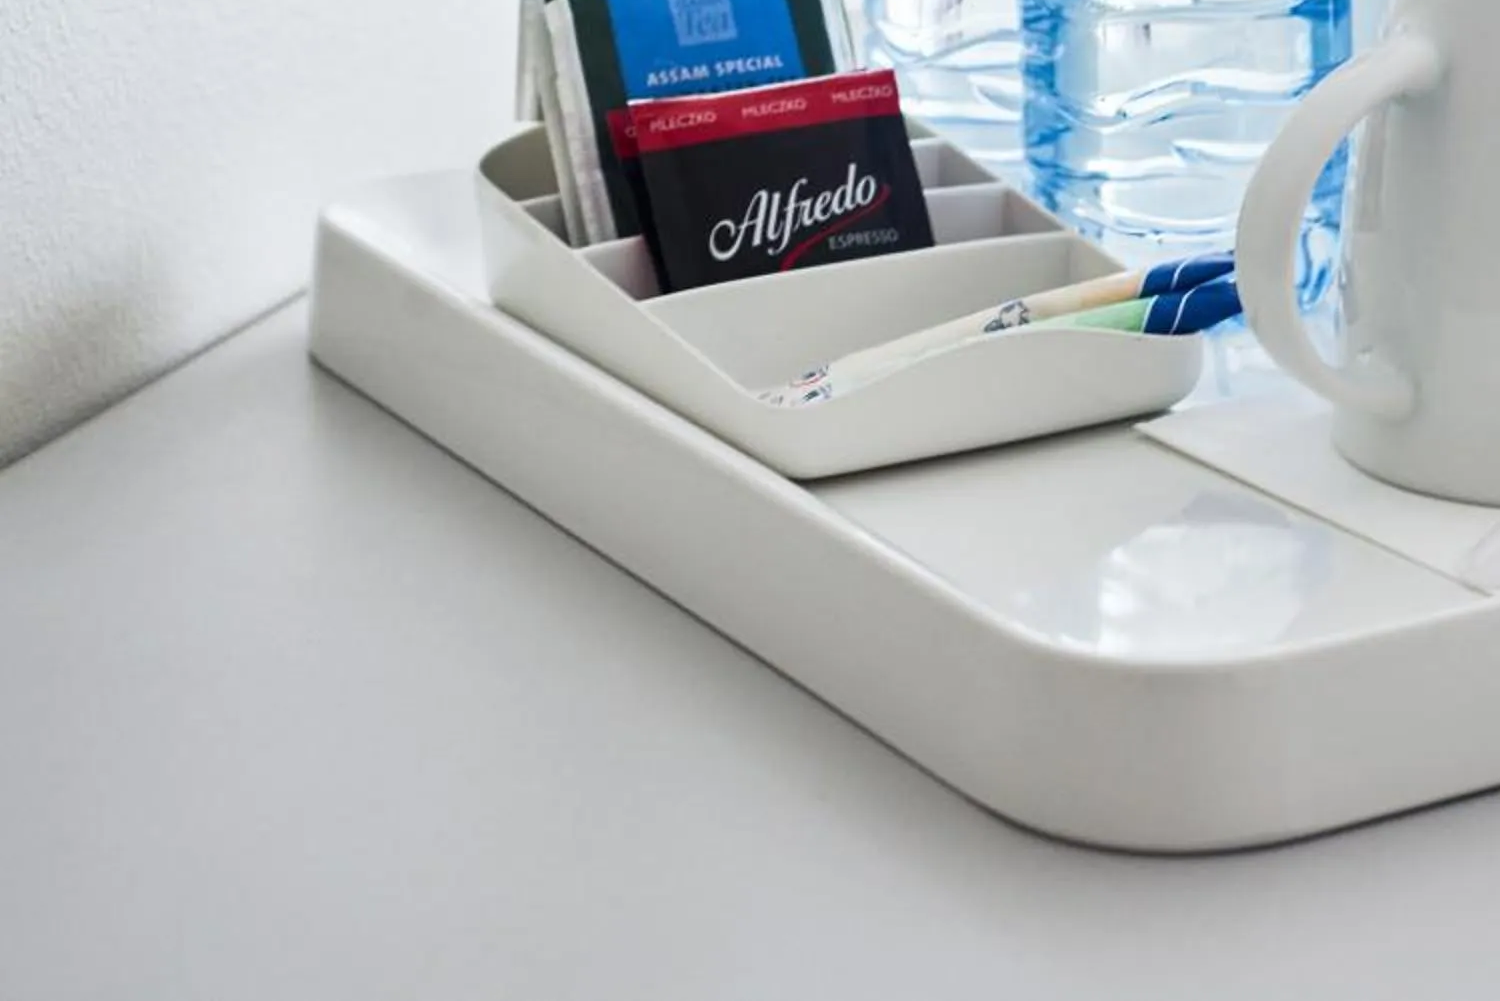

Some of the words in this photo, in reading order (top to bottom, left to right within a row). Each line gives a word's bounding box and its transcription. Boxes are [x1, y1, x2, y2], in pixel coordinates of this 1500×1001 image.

[646, 64, 710, 87] ASSAM
[714, 54, 784, 77] SPECIAL
[831, 85, 893, 104] MLECZKO
[741, 97, 807, 119] MLECZKO
[650, 110, 718, 134] MLECZKO
[709, 162, 877, 261] Alfredo
[829, 227, 899, 250] ESPRESSO
